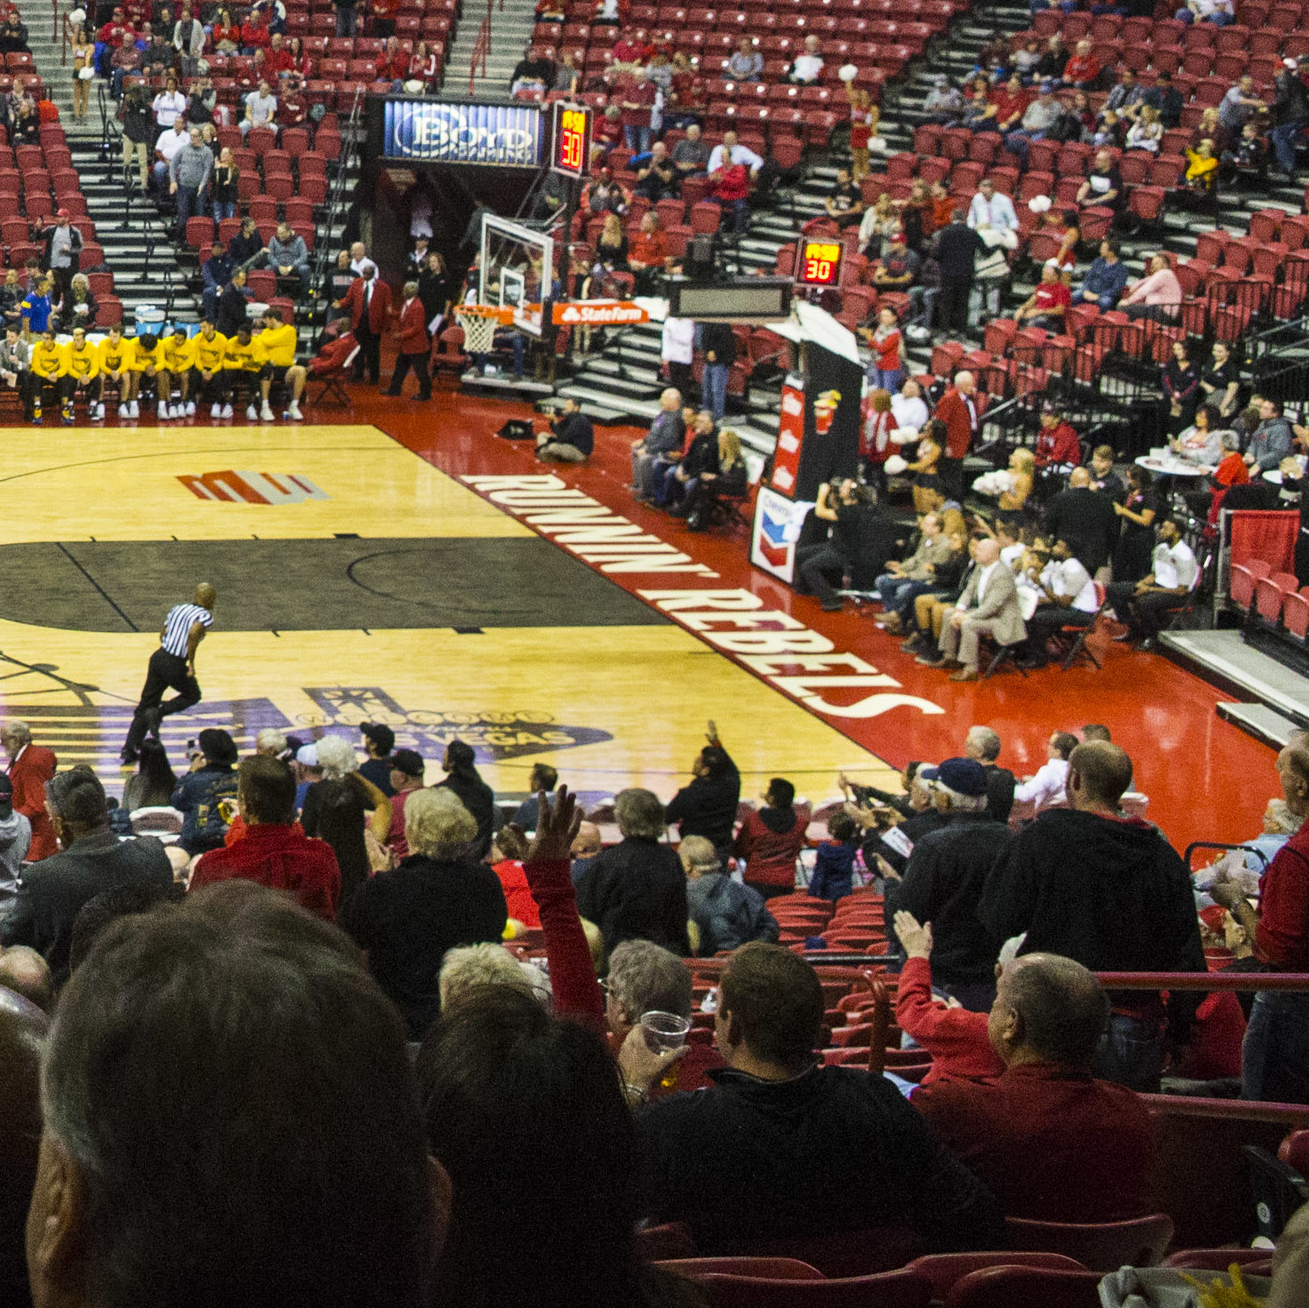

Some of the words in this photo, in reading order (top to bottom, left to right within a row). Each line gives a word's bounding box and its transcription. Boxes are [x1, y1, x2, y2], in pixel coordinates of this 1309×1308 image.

[561, 130, 581, 168] 30
[806, 260, 830, 282] 30
[460, 474, 720, 579] RUNNIN'
[636, 588, 945, 719] REBELS
[431, 730, 576, 747] VEGAS
